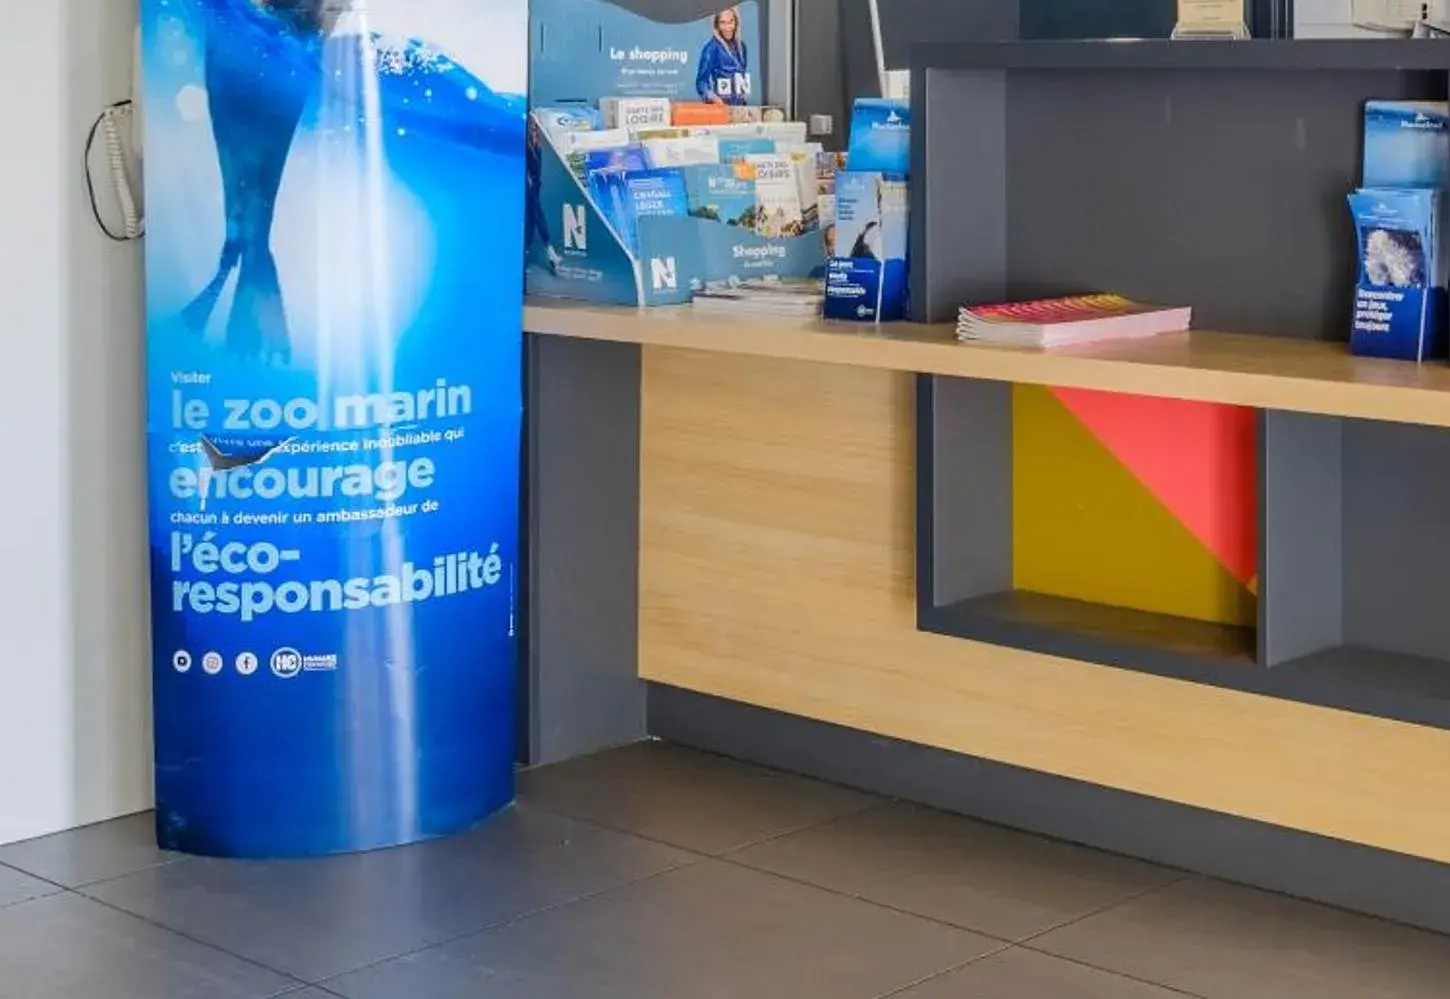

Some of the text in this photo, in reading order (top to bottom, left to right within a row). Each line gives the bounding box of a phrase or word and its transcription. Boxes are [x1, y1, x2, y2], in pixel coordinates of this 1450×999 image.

[629, 45, 688, 65] shopping
[732, 243, 786, 260] Shopping
[171, 371, 212, 385] Visiter
[172, 378, 473, 431] le zoo marin
[279, 439, 358, 454] xpérience
[444, 427, 465, 442] qui
[169, 456, 436, 501] encourage
[169, 509, 218, 525] chacun
[233, 511, 289, 525] devenir
[293, 511, 313, 524] un
[316, 503, 418, 524] ambassadeur
[421, 499, 440, 512] de
[170, 530, 301, 573] l'éco-
[171, 542, 502, 623] responsabilité
